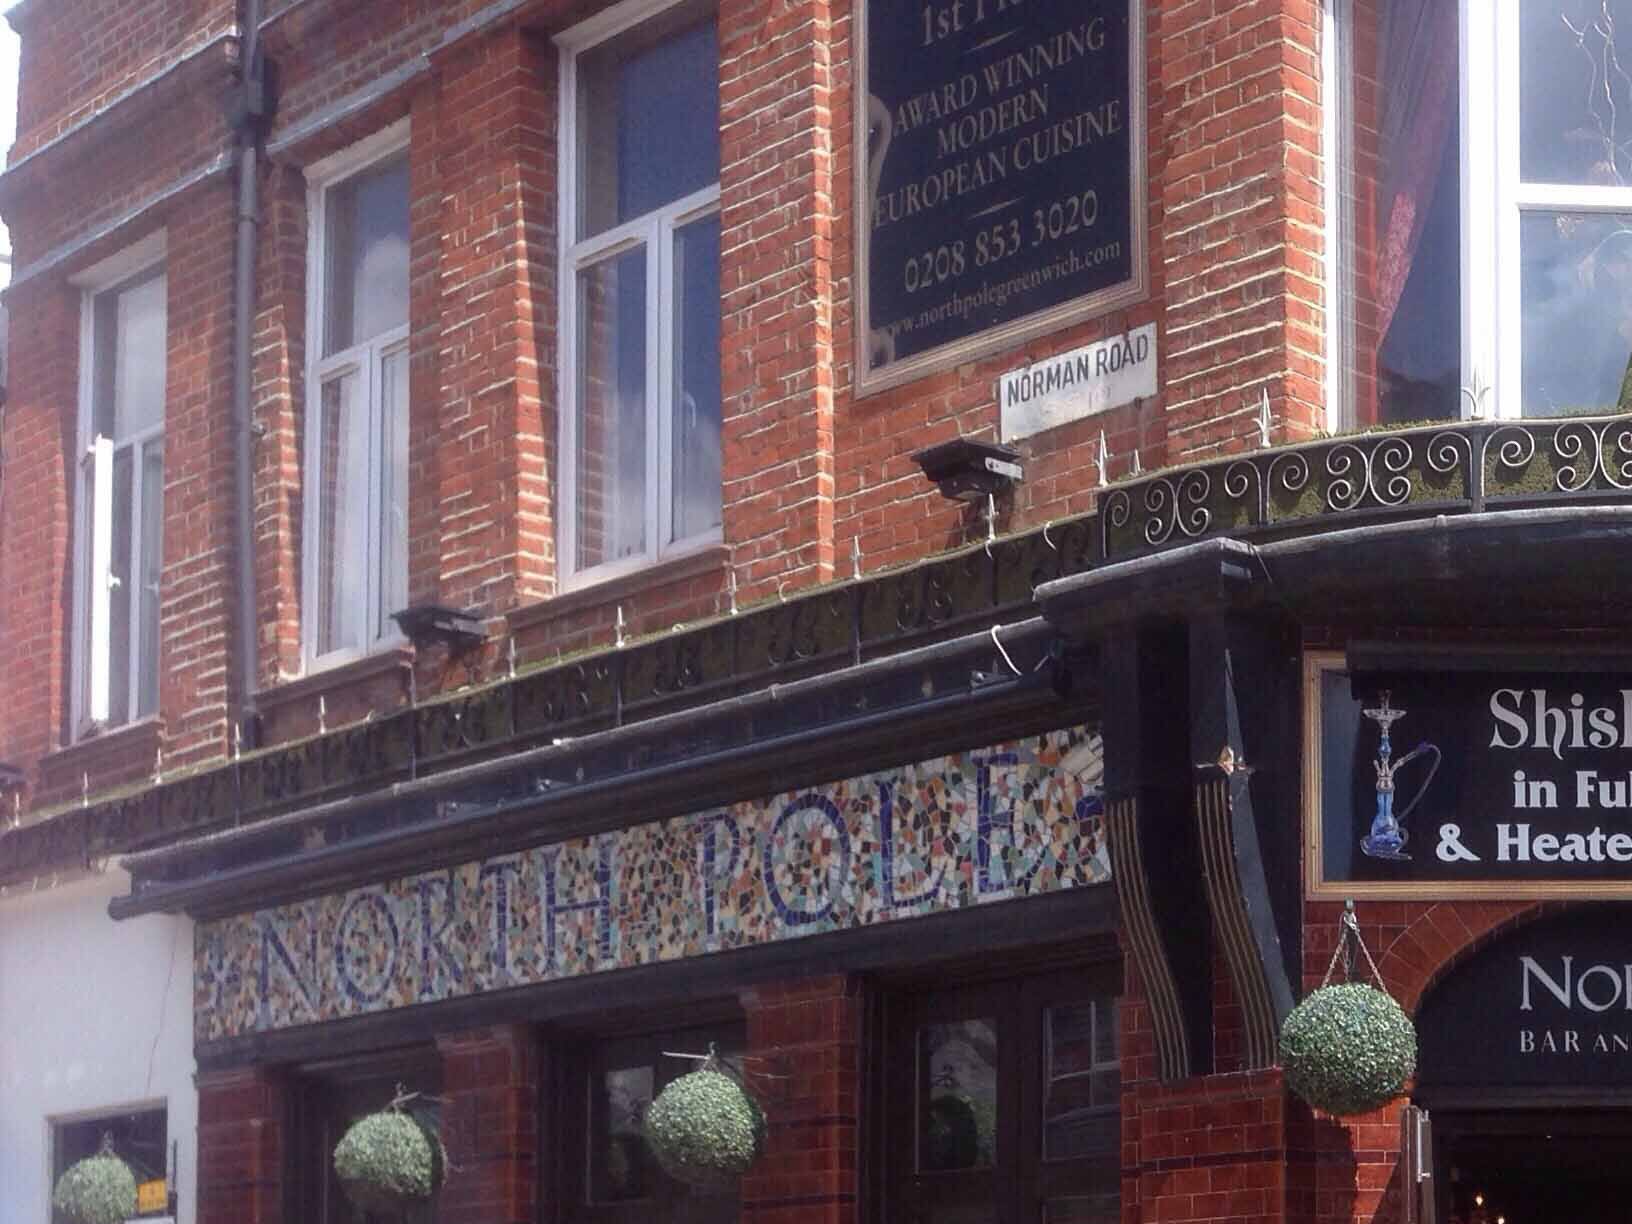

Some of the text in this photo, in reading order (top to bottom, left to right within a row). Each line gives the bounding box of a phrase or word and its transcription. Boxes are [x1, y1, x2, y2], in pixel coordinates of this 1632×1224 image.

[893, 16, 1105, 137] AWARD WINNING
[936, 83, 1049, 159] MODERN
[874, 100, 1121, 229] EUROPEAN CUISINE
[904, 190, 1098, 293] 0208 853 3020
[1007, 334, 1149, 407] NORMAN ROAD
[1513, 770, 1562, 808] in
[1434, 824, 1481, 862] &
[252, 751, 1019, 1032] NORTH POLE
[1519, 1029, 1581, 1053] BAR
